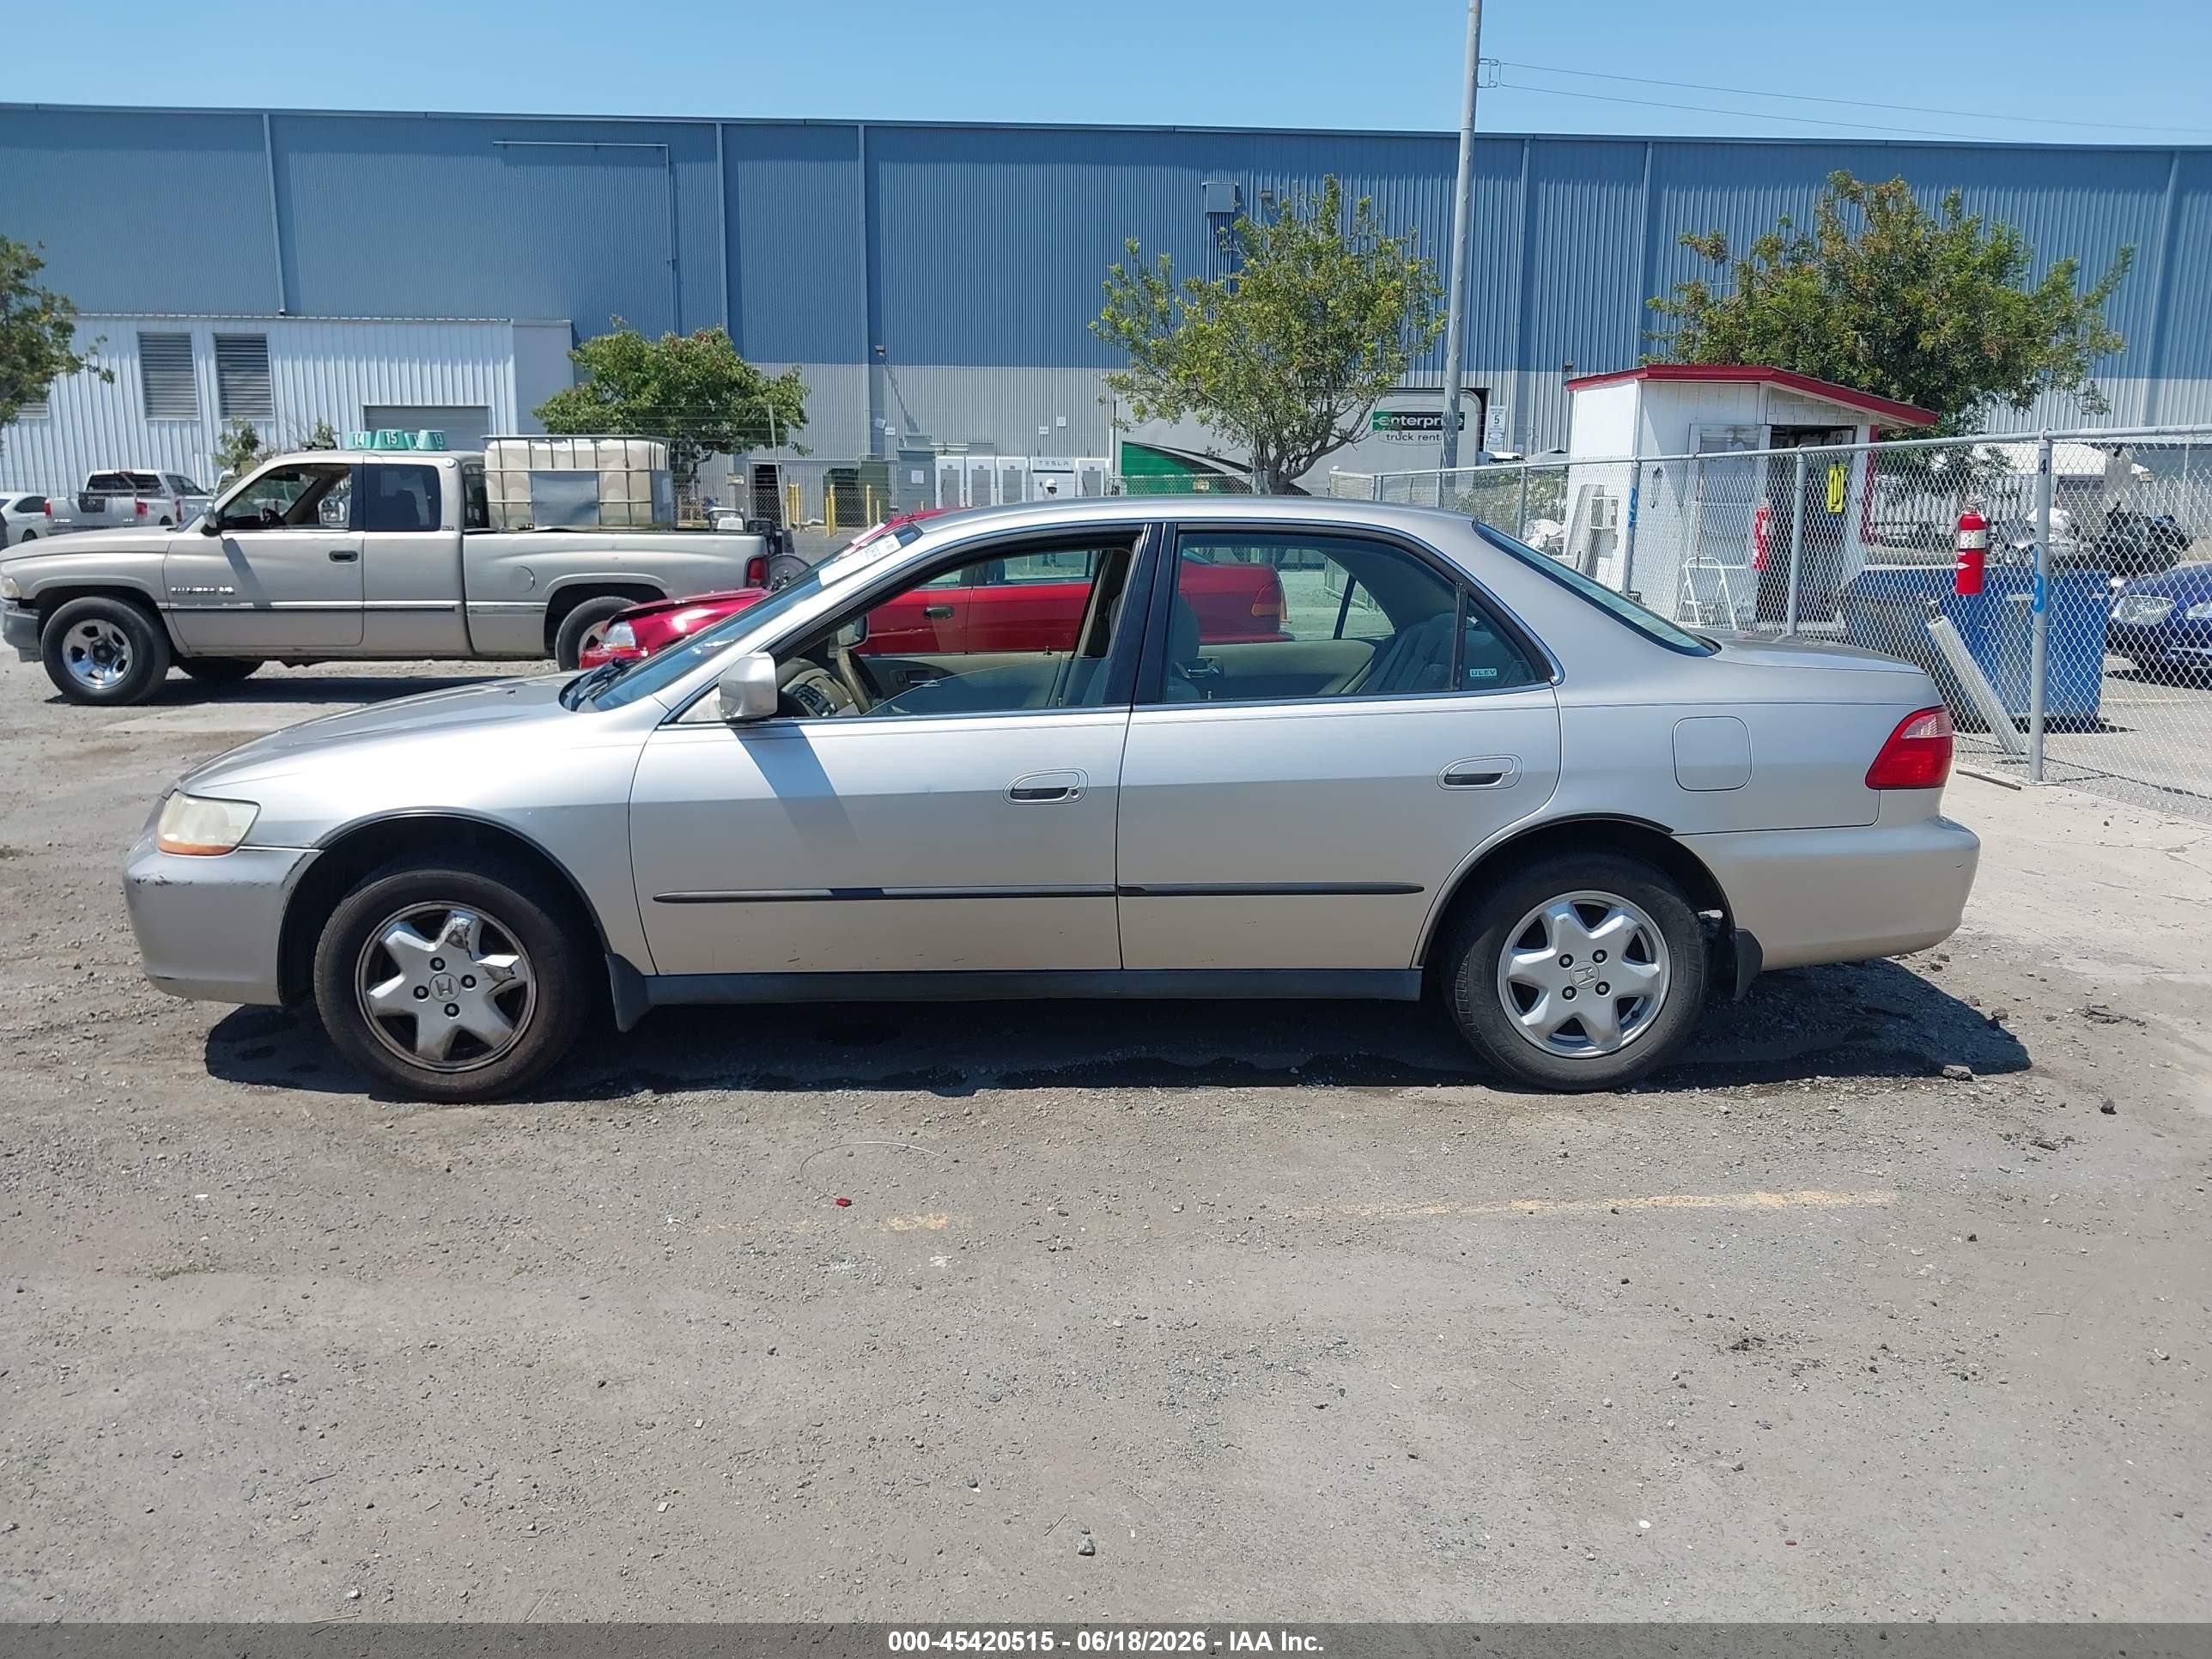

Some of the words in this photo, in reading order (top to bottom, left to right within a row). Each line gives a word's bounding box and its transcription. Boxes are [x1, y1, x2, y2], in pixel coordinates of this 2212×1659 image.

[1374, 416, 1463, 428] enterprie
[1494, 415, 1500, 425] 5
[353, 432, 365, 446] 14
[386, 431, 398, 445] 15
[1386, 432, 1414, 441] truck
[1418, 432, 1443, 441] rent
[2039, 459, 2047, 474] 4
